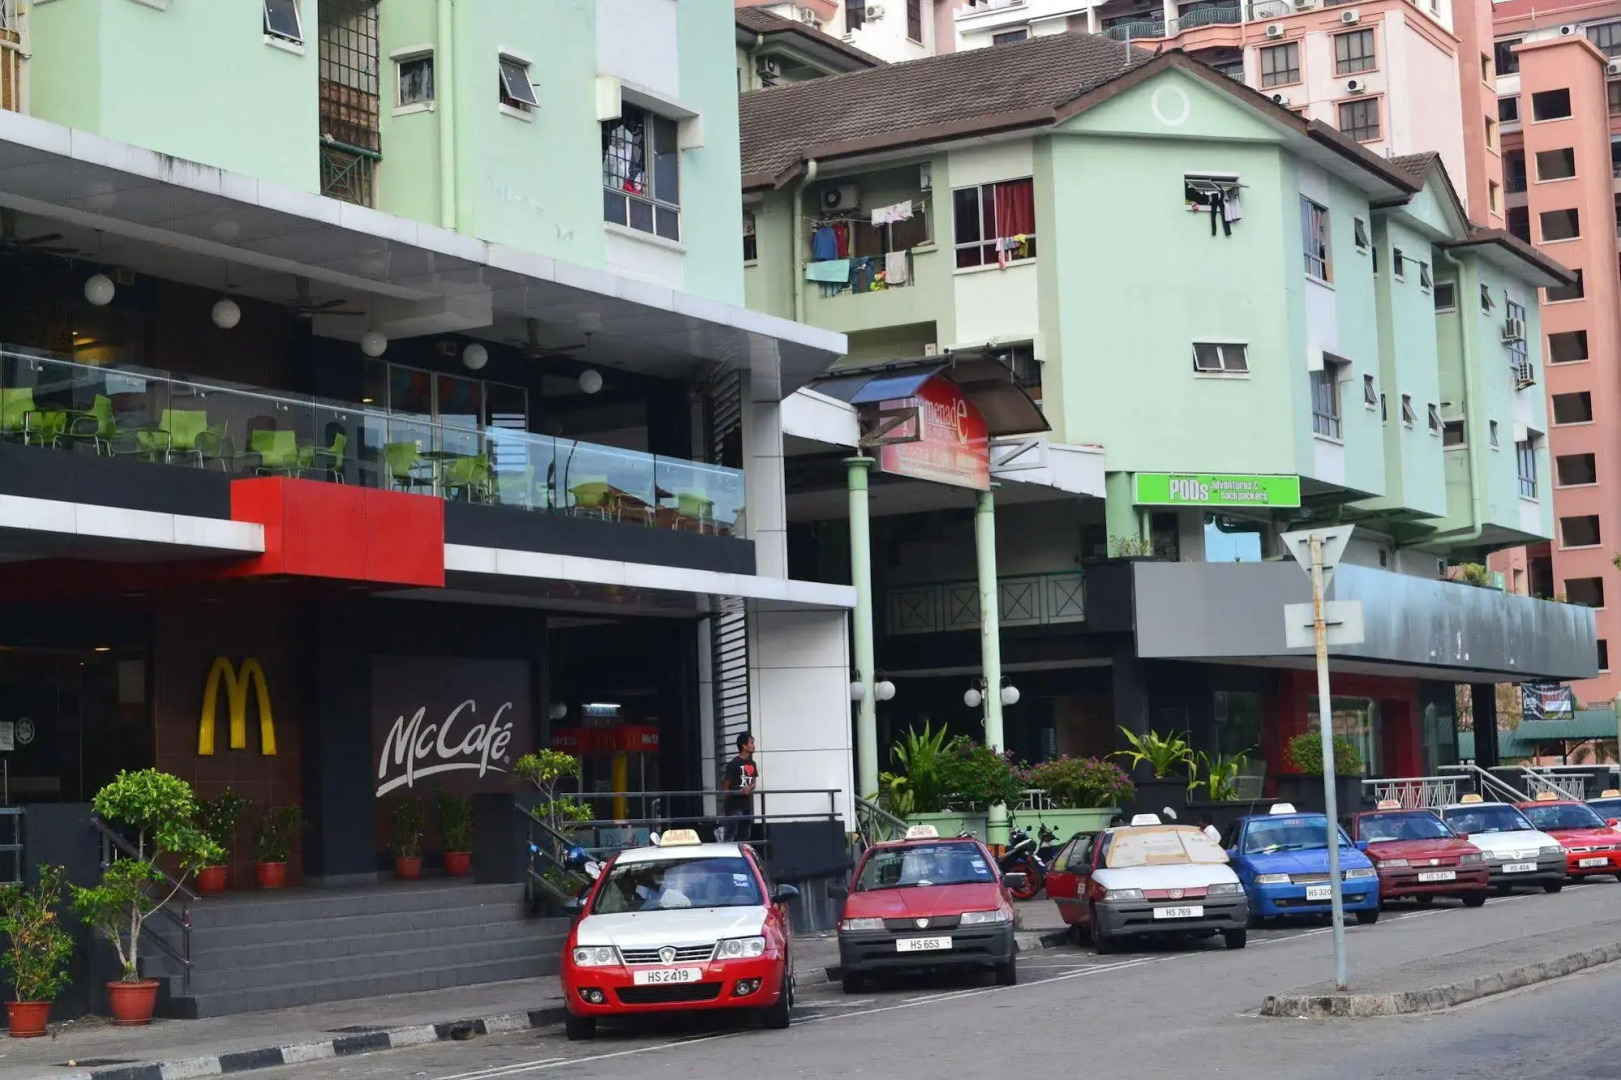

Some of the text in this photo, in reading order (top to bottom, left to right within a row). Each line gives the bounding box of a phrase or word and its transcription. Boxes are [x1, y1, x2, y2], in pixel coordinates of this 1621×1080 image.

[1169, 479, 1209, 501] PODs
[1211, 480, 1251, 490] adventures
[1220, 490, 1268, 501] backpackers
[378, 698, 513, 788] McCafé
[1308, 889, 1318, 897] HS
[1165, 907, 1191, 917] HS 769
[910, 939, 939, 950] HS 653
[648, 970, 689, 982] HS 2419
